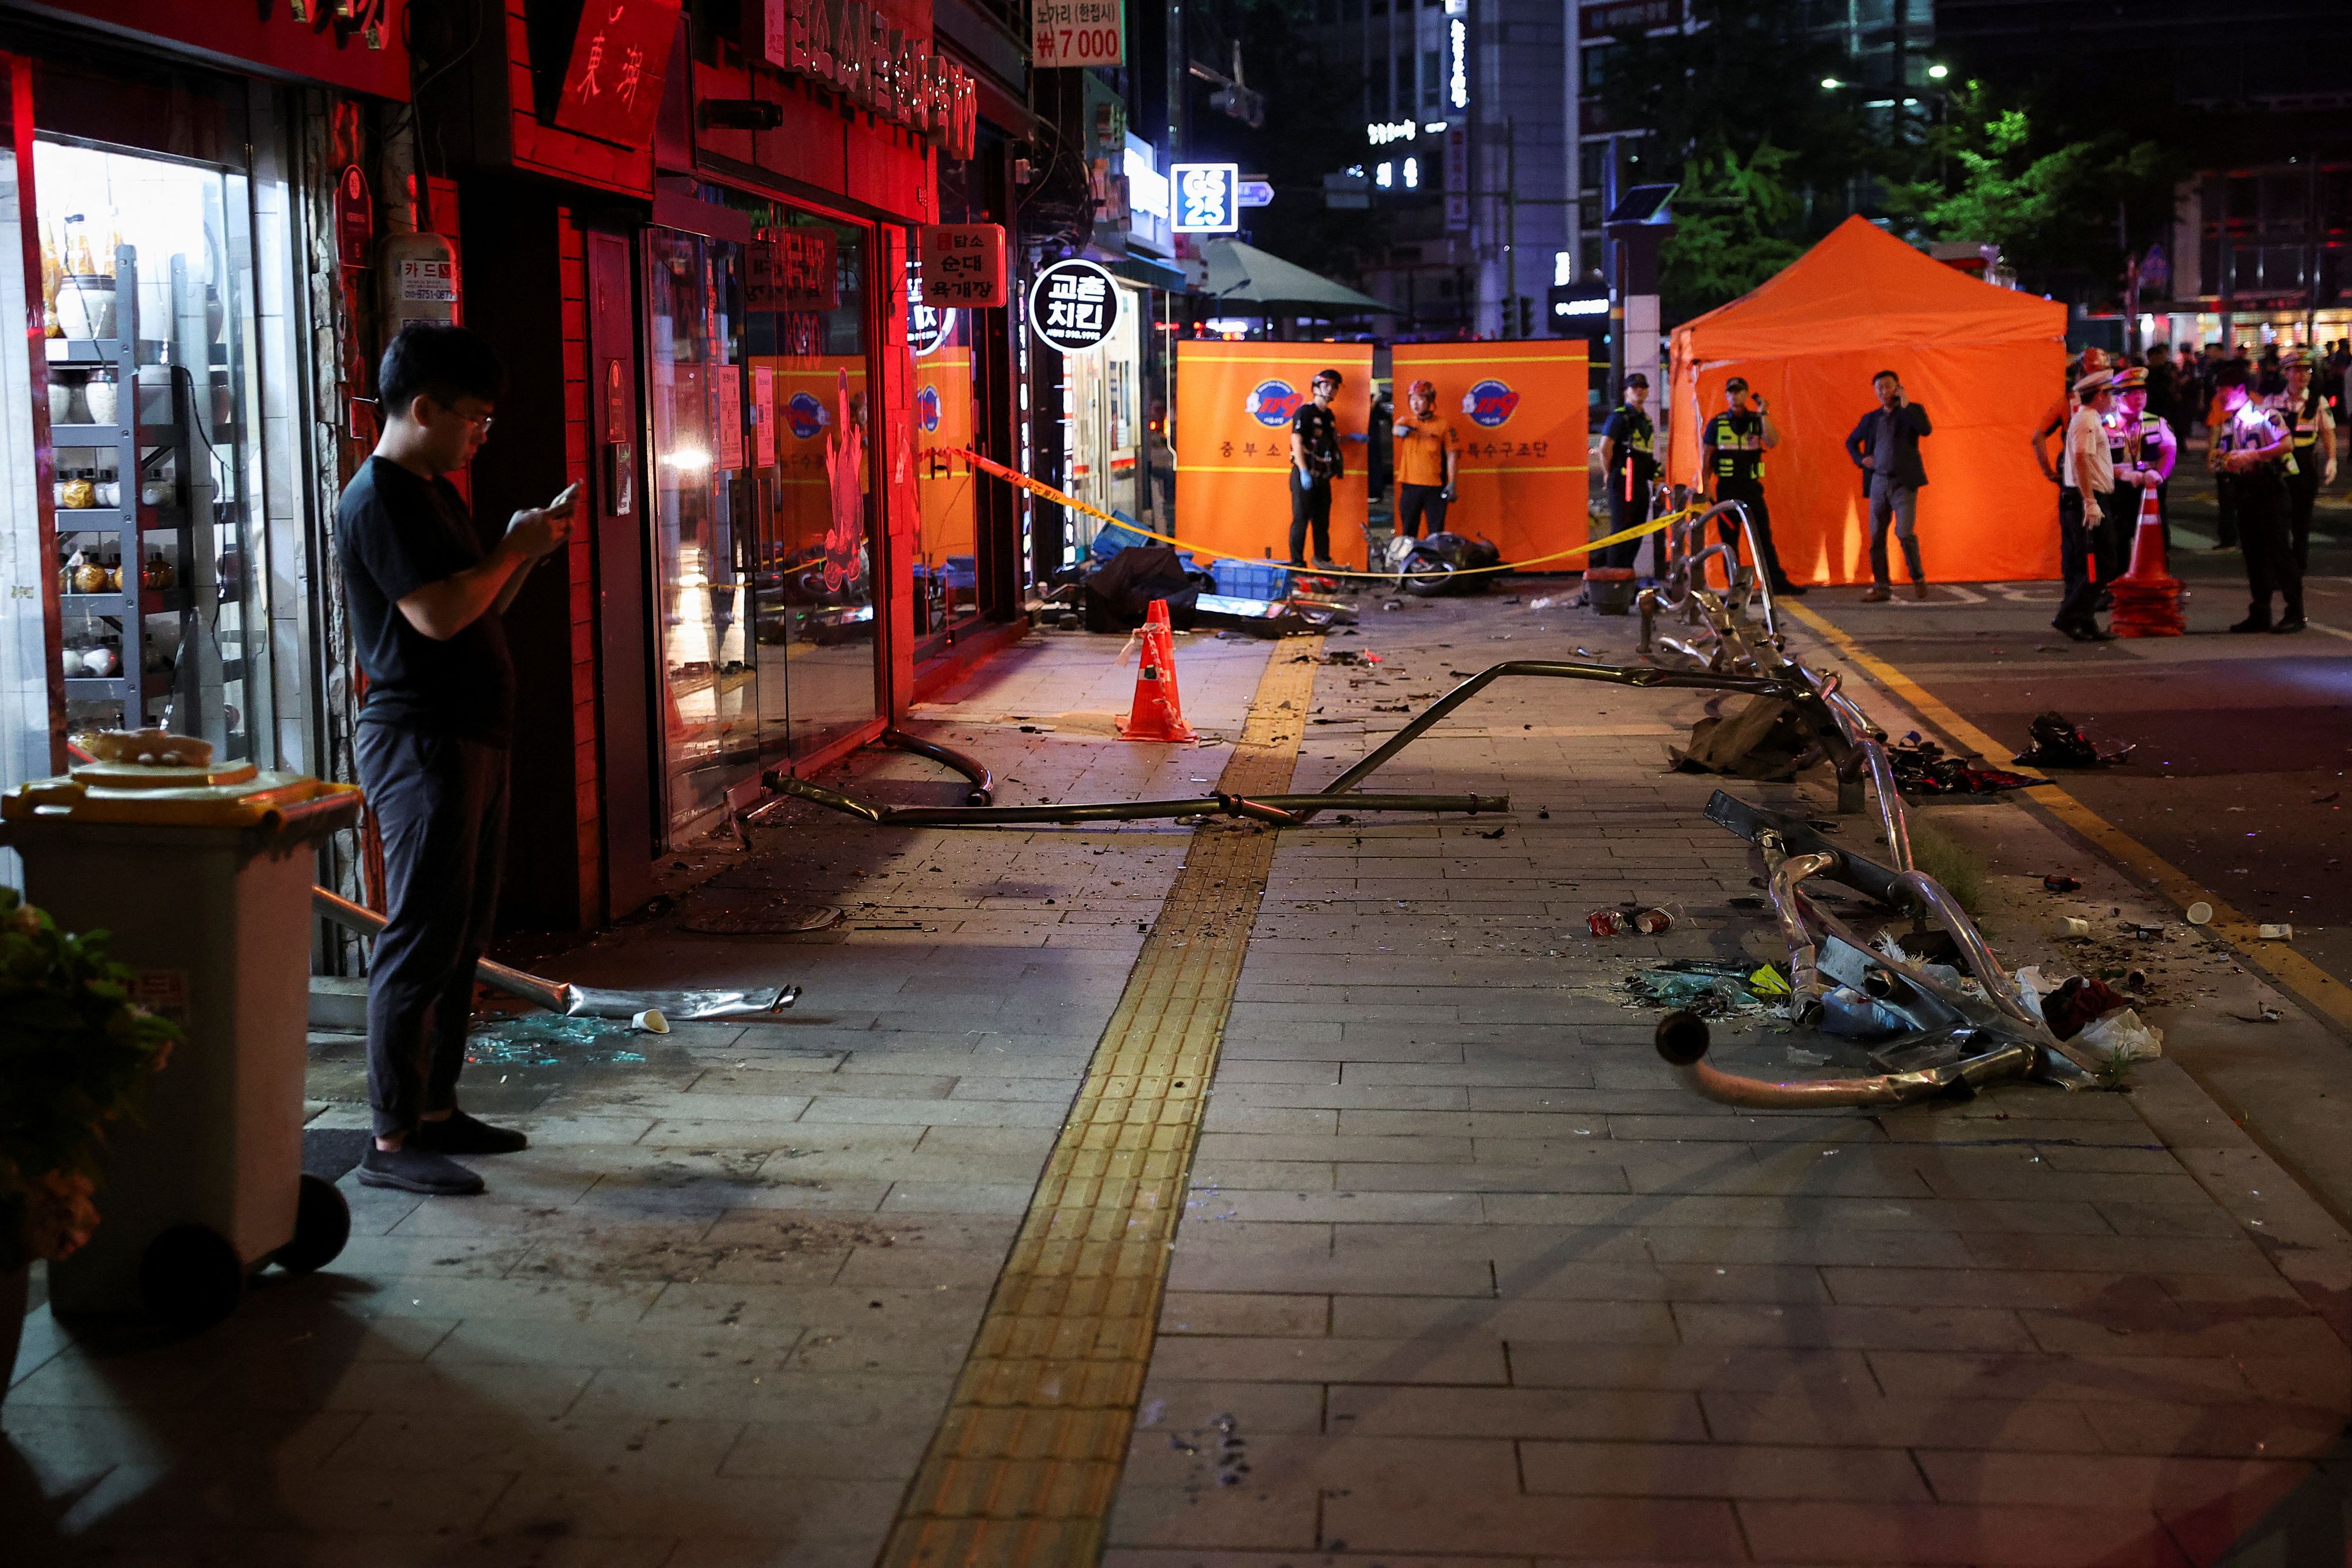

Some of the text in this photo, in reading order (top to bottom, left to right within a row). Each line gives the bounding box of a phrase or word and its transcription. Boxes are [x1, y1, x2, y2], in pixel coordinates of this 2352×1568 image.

[1037, 4, 1071, 24] 노가리
[1182, 170, 1225, 199] GS
[1184, 197, 1225, 226] 25
[954, 235, 984, 248] 담소
[405, 263, 437, 278] 카드
[941, 255, 981, 272] 순대
[930, 281, 993, 298] 육개장
[1048, 275, 1105, 302] 교촌
[1047, 300, 1103, 330] 치킨
[1259, 393, 1304, 417] 119
[1475, 392, 1520, 417] 119
[1220, 441, 1293, 458] 중부소
